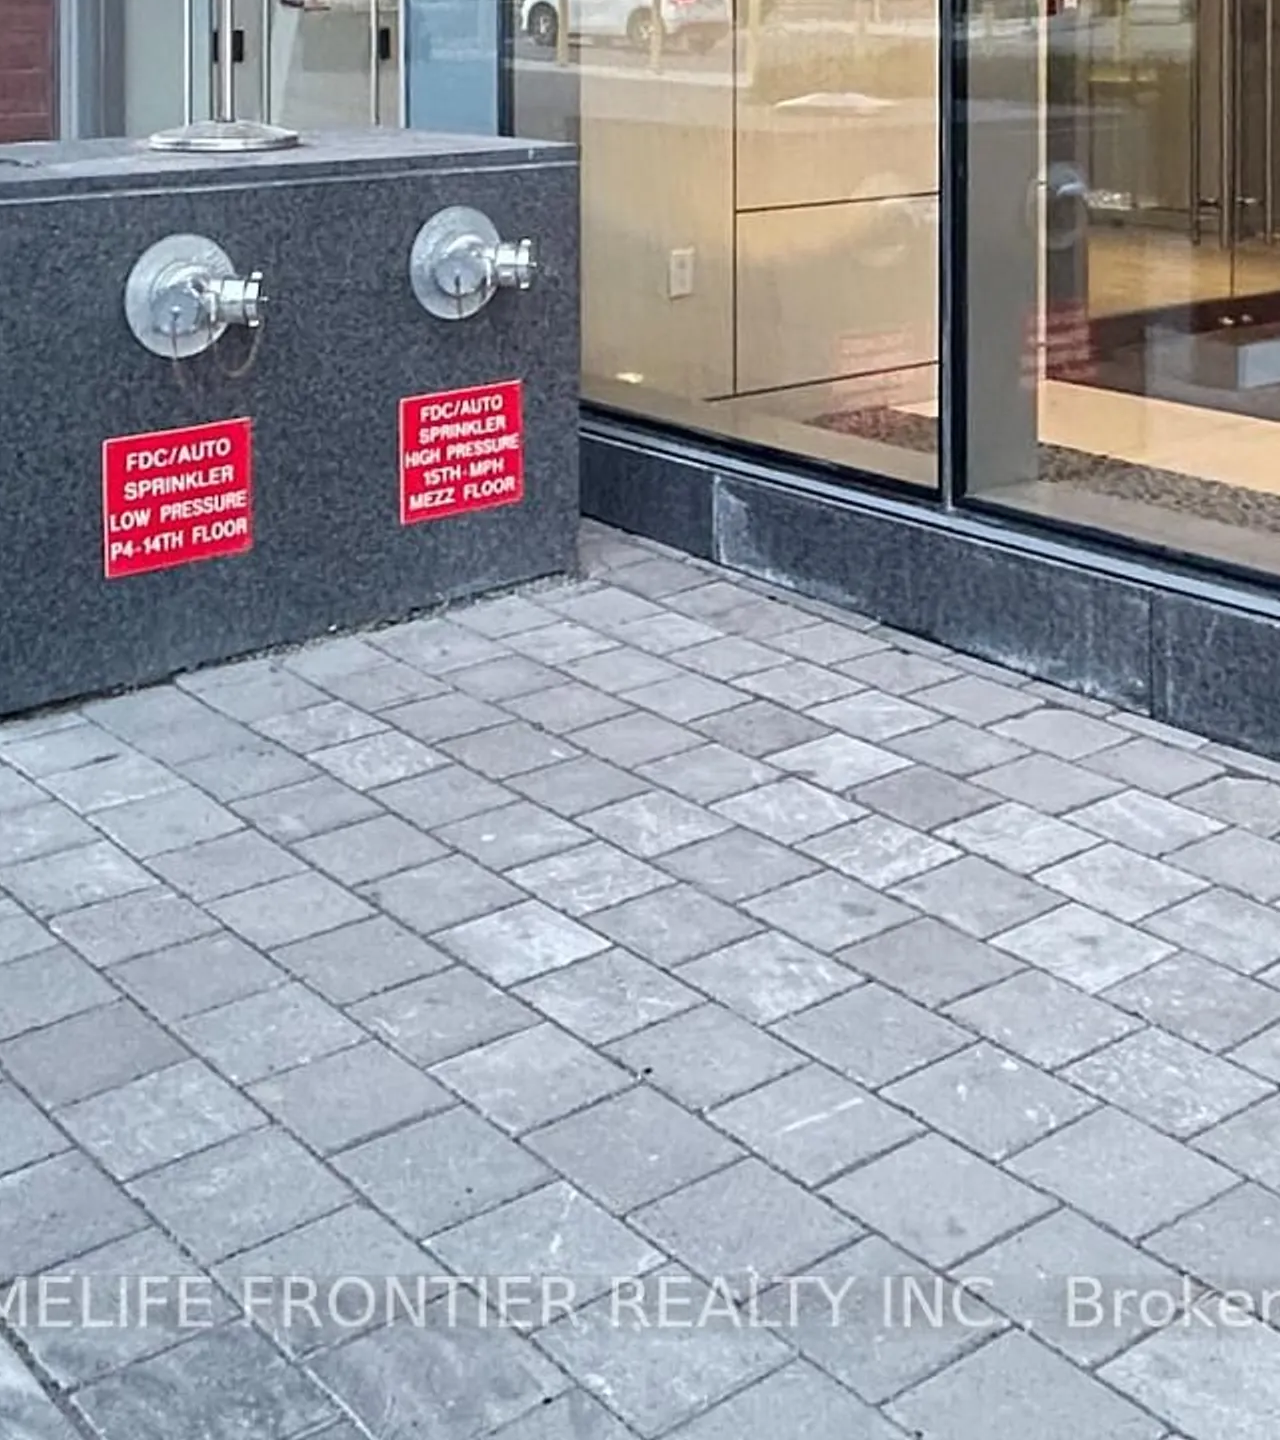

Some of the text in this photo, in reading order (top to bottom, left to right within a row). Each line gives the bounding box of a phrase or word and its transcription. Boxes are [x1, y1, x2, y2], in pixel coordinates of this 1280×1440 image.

[421, 395, 503, 422] FDC/AUTO
[419, 415, 506, 445] SPRINKLER
[126, 438, 231, 472] FDC/AUTO
[405, 433, 519, 468] HIGH PRESSURE
[124, 465, 234, 500] SPRINKLER
[409, 476, 515, 510] MEZZ FLOOR
[110, 490, 247, 532] LOW PRESSURE
[110, 517, 247, 560] P4-14TH FLOOR
